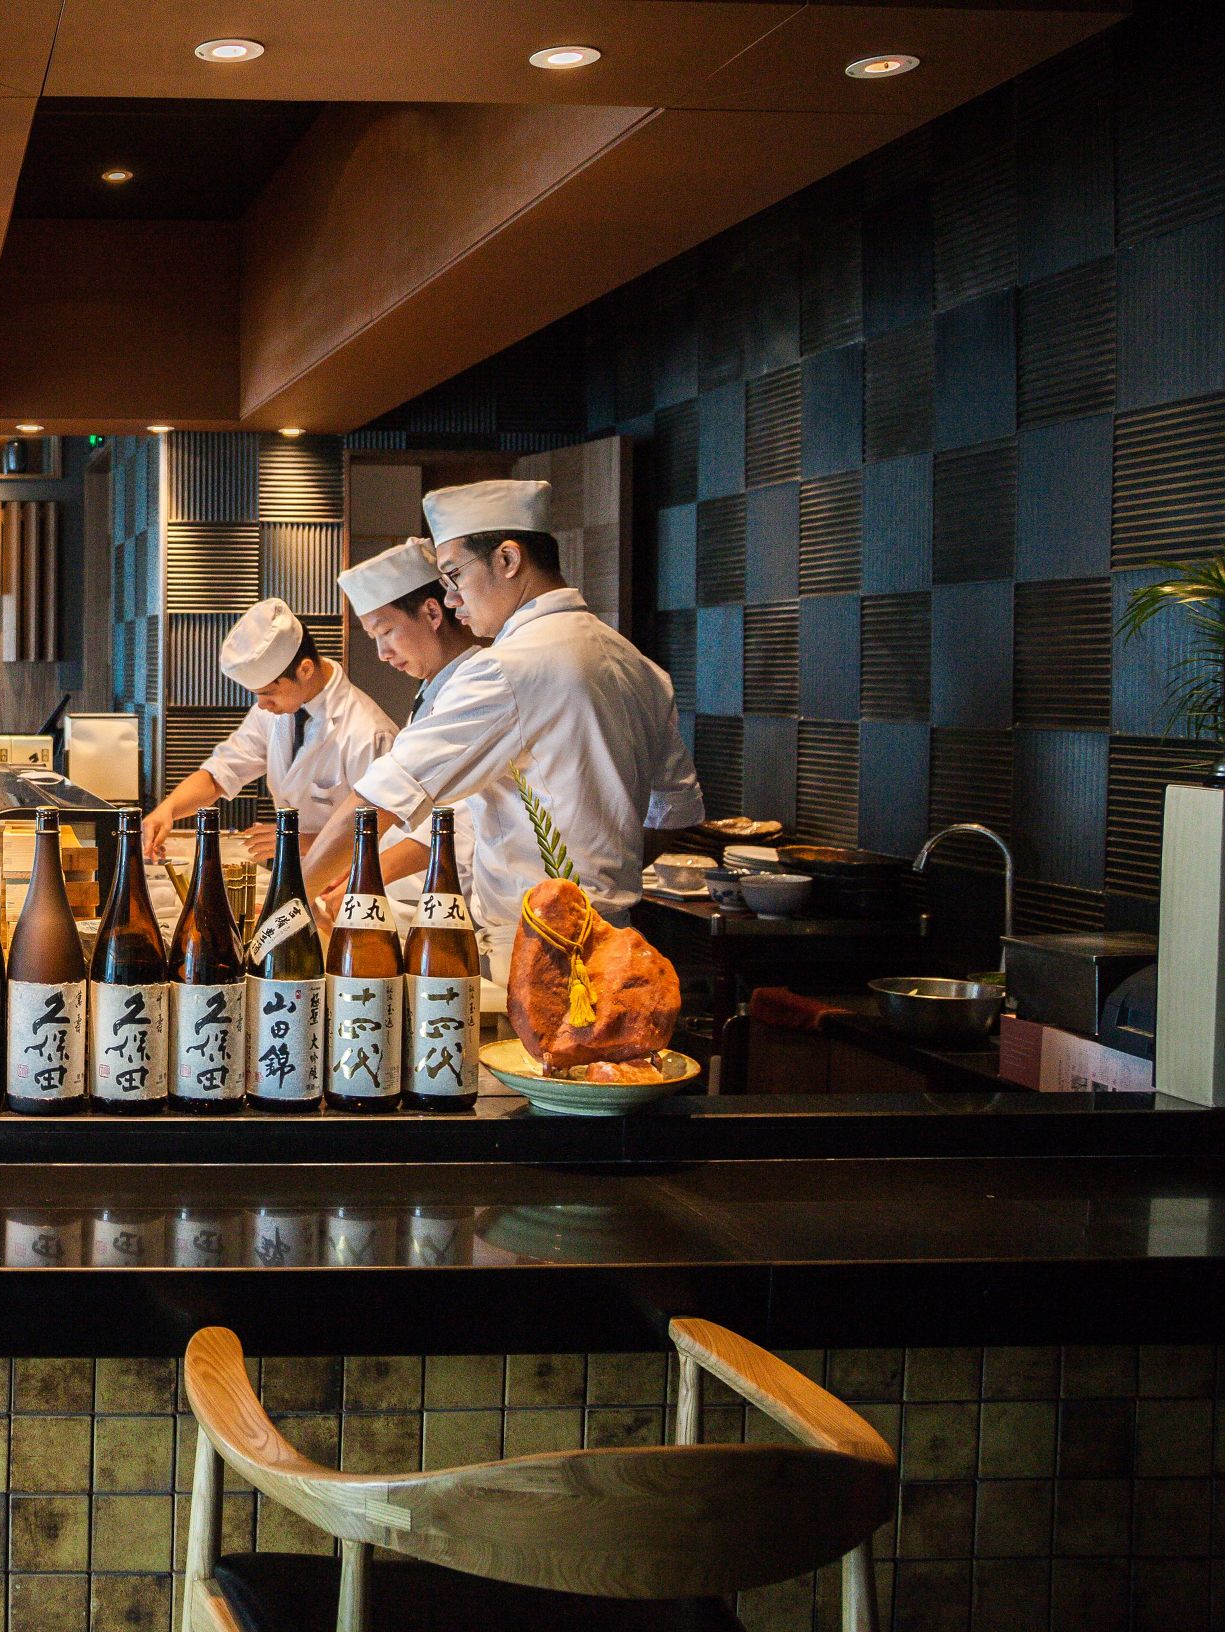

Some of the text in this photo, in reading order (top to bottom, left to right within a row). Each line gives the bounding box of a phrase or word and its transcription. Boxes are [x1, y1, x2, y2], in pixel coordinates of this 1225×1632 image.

[345, 896, 385, 922] 本丸
[424, 895, 465, 921] 本丸
[24, 990, 70, 1092] 久保田
[104, 991, 152, 1093] 久保田
[185, 990, 233, 1092] 久保田
[258, 991, 297, 1089] 山田錦
[332, 987, 384, 1089] 十四代
[414, 986, 465, 1087] 十四代
